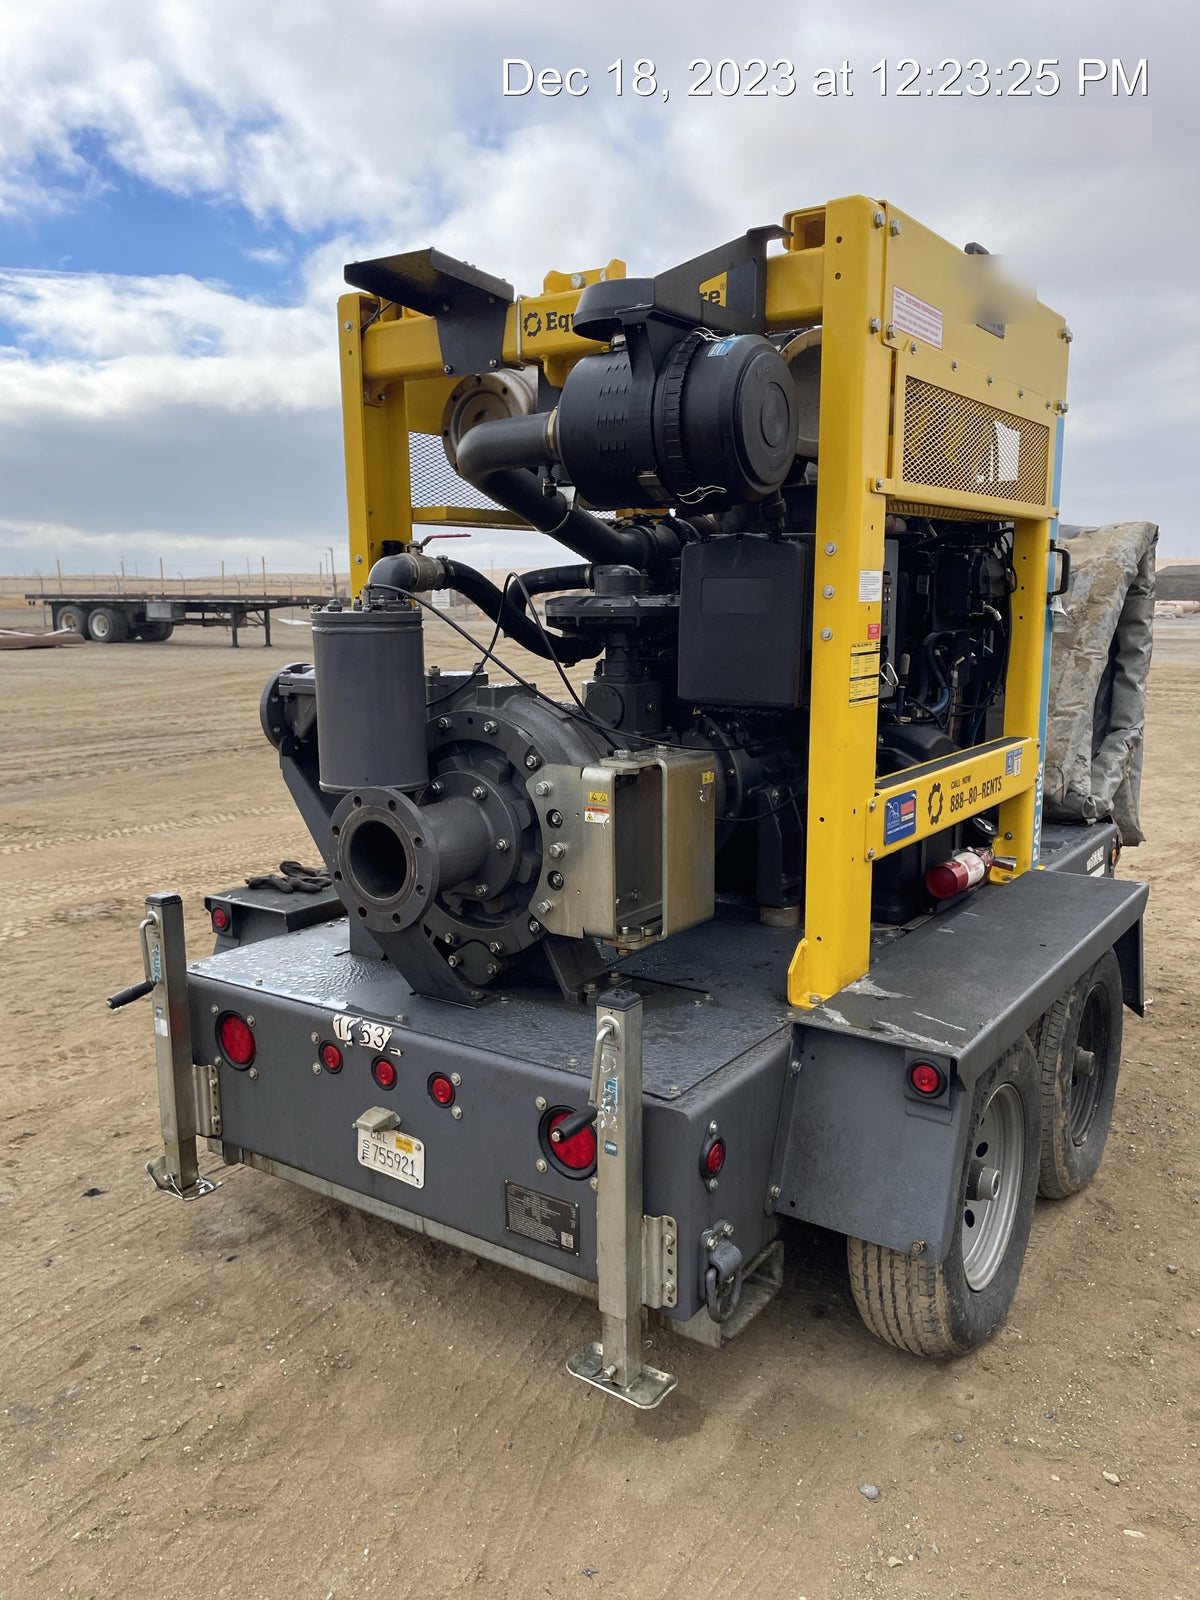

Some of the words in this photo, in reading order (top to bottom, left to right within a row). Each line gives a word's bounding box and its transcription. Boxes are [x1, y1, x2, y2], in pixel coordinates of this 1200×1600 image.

[545, 311, 574, 333] Eq
[949, 774, 1002, 813] 888-80-RENTS
[950, 779, 961, 790] CALL
[962, 774, 972, 785] NOW
[1035, 760, 1045, 807] H64
[1032, 813, 1041, 862] PAC
[370, 1130, 388, 1145] CAL
[371, 1142, 416, 1179] 755921
